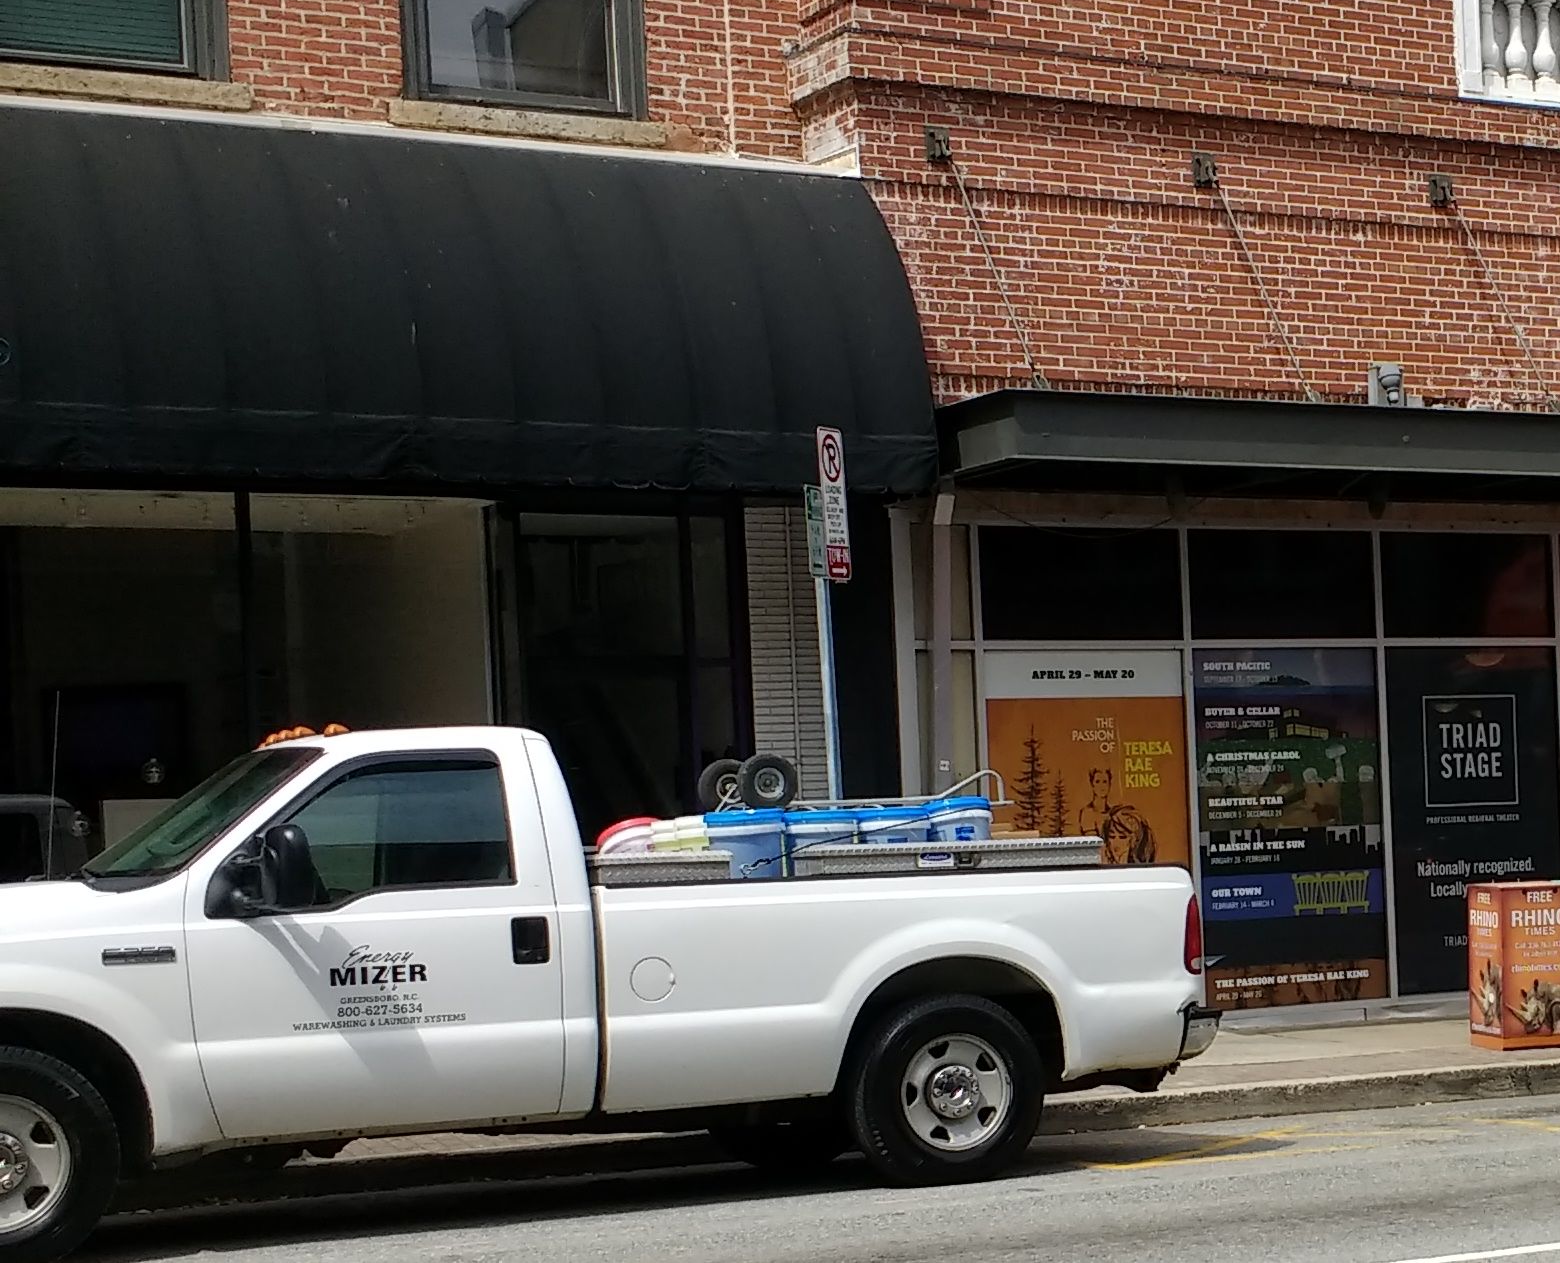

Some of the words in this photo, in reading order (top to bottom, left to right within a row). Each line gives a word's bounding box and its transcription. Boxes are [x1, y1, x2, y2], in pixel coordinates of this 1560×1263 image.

[1203, 662, 1234, 671] SOUTH
[1236, 662, 1271, 671] PACIFIC
[1032, 671, 1066, 679] APRIL
[1068, 670, 1082, 679] 29
[1093, 670, 1119, 679] MAY
[1120, 670, 1135, 679] 20
[1204, 707, 1236, 717] BUYER
[1246, 707, 1281, 716] CELLAR
[1096, 717, 1114, 728] THE
[1072, 729, 1114, 741] PASSION
[1439, 722, 1501, 748] TRIAD
[1100, 742, 1115, 753] OF
[1124, 741, 1172, 755] TERESA
[1207, 753, 1215, 762] A
[1215, 752, 1270, 762] CHRISTMAS
[1270, 751, 1301, 760] CAROL
[1125, 758, 1152, 771] RAE
[1440, 752, 1503, 779] STAGE
[1125, 774, 1160, 788] KING
[1208, 797, 1259, 807] BEAUTIFUL
[1259, 796, 1284, 805] STAR
[1210, 844, 1217, 852] A
[1218, 843, 1252, 852] RAISIN
[1253, 842, 1264, 851] IN
[1266, 841, 1285, 850] THE
[1286, 840, 1306, 849] SUN
[1417, 860, 1471, 877] Nationally
[1473, 857, 1535, 875] recognized.
[1211, 889, 1231, 898] OUR
[1232, 887, 1262, 896] TOWN
[1430, 882, 1468, 898] Locally
[1527, 890, 1553, 903] FREE
[1477, 892, 1491, 905] FREE
[1470, 909, 1499, 929] RHINO
[1525, 926, 1556, 936] TIMES
[342, 944, 414, 969] Energy
[330, 964, 428, 987] MIZER
[1215, 979, 1235, 989] THE
[1236, 976, 1275, 987] PASSION
[1276, 975, 1289, 984] OF
[1290, 972, 1326, 983] TERESA
[1326, 971, 1345, 980] RAE
[1346, 969, 1369, 979] KING
[337, 1003, 423, 1018] 800-627-5634
[293, 1018, 367, 1031] WAREWASHING
[369, 1018, 376, 1027] &
[378, 1016, 422, 1027] LAUNDRY
[424, 1013, 467, 1024] SYSTEMS
